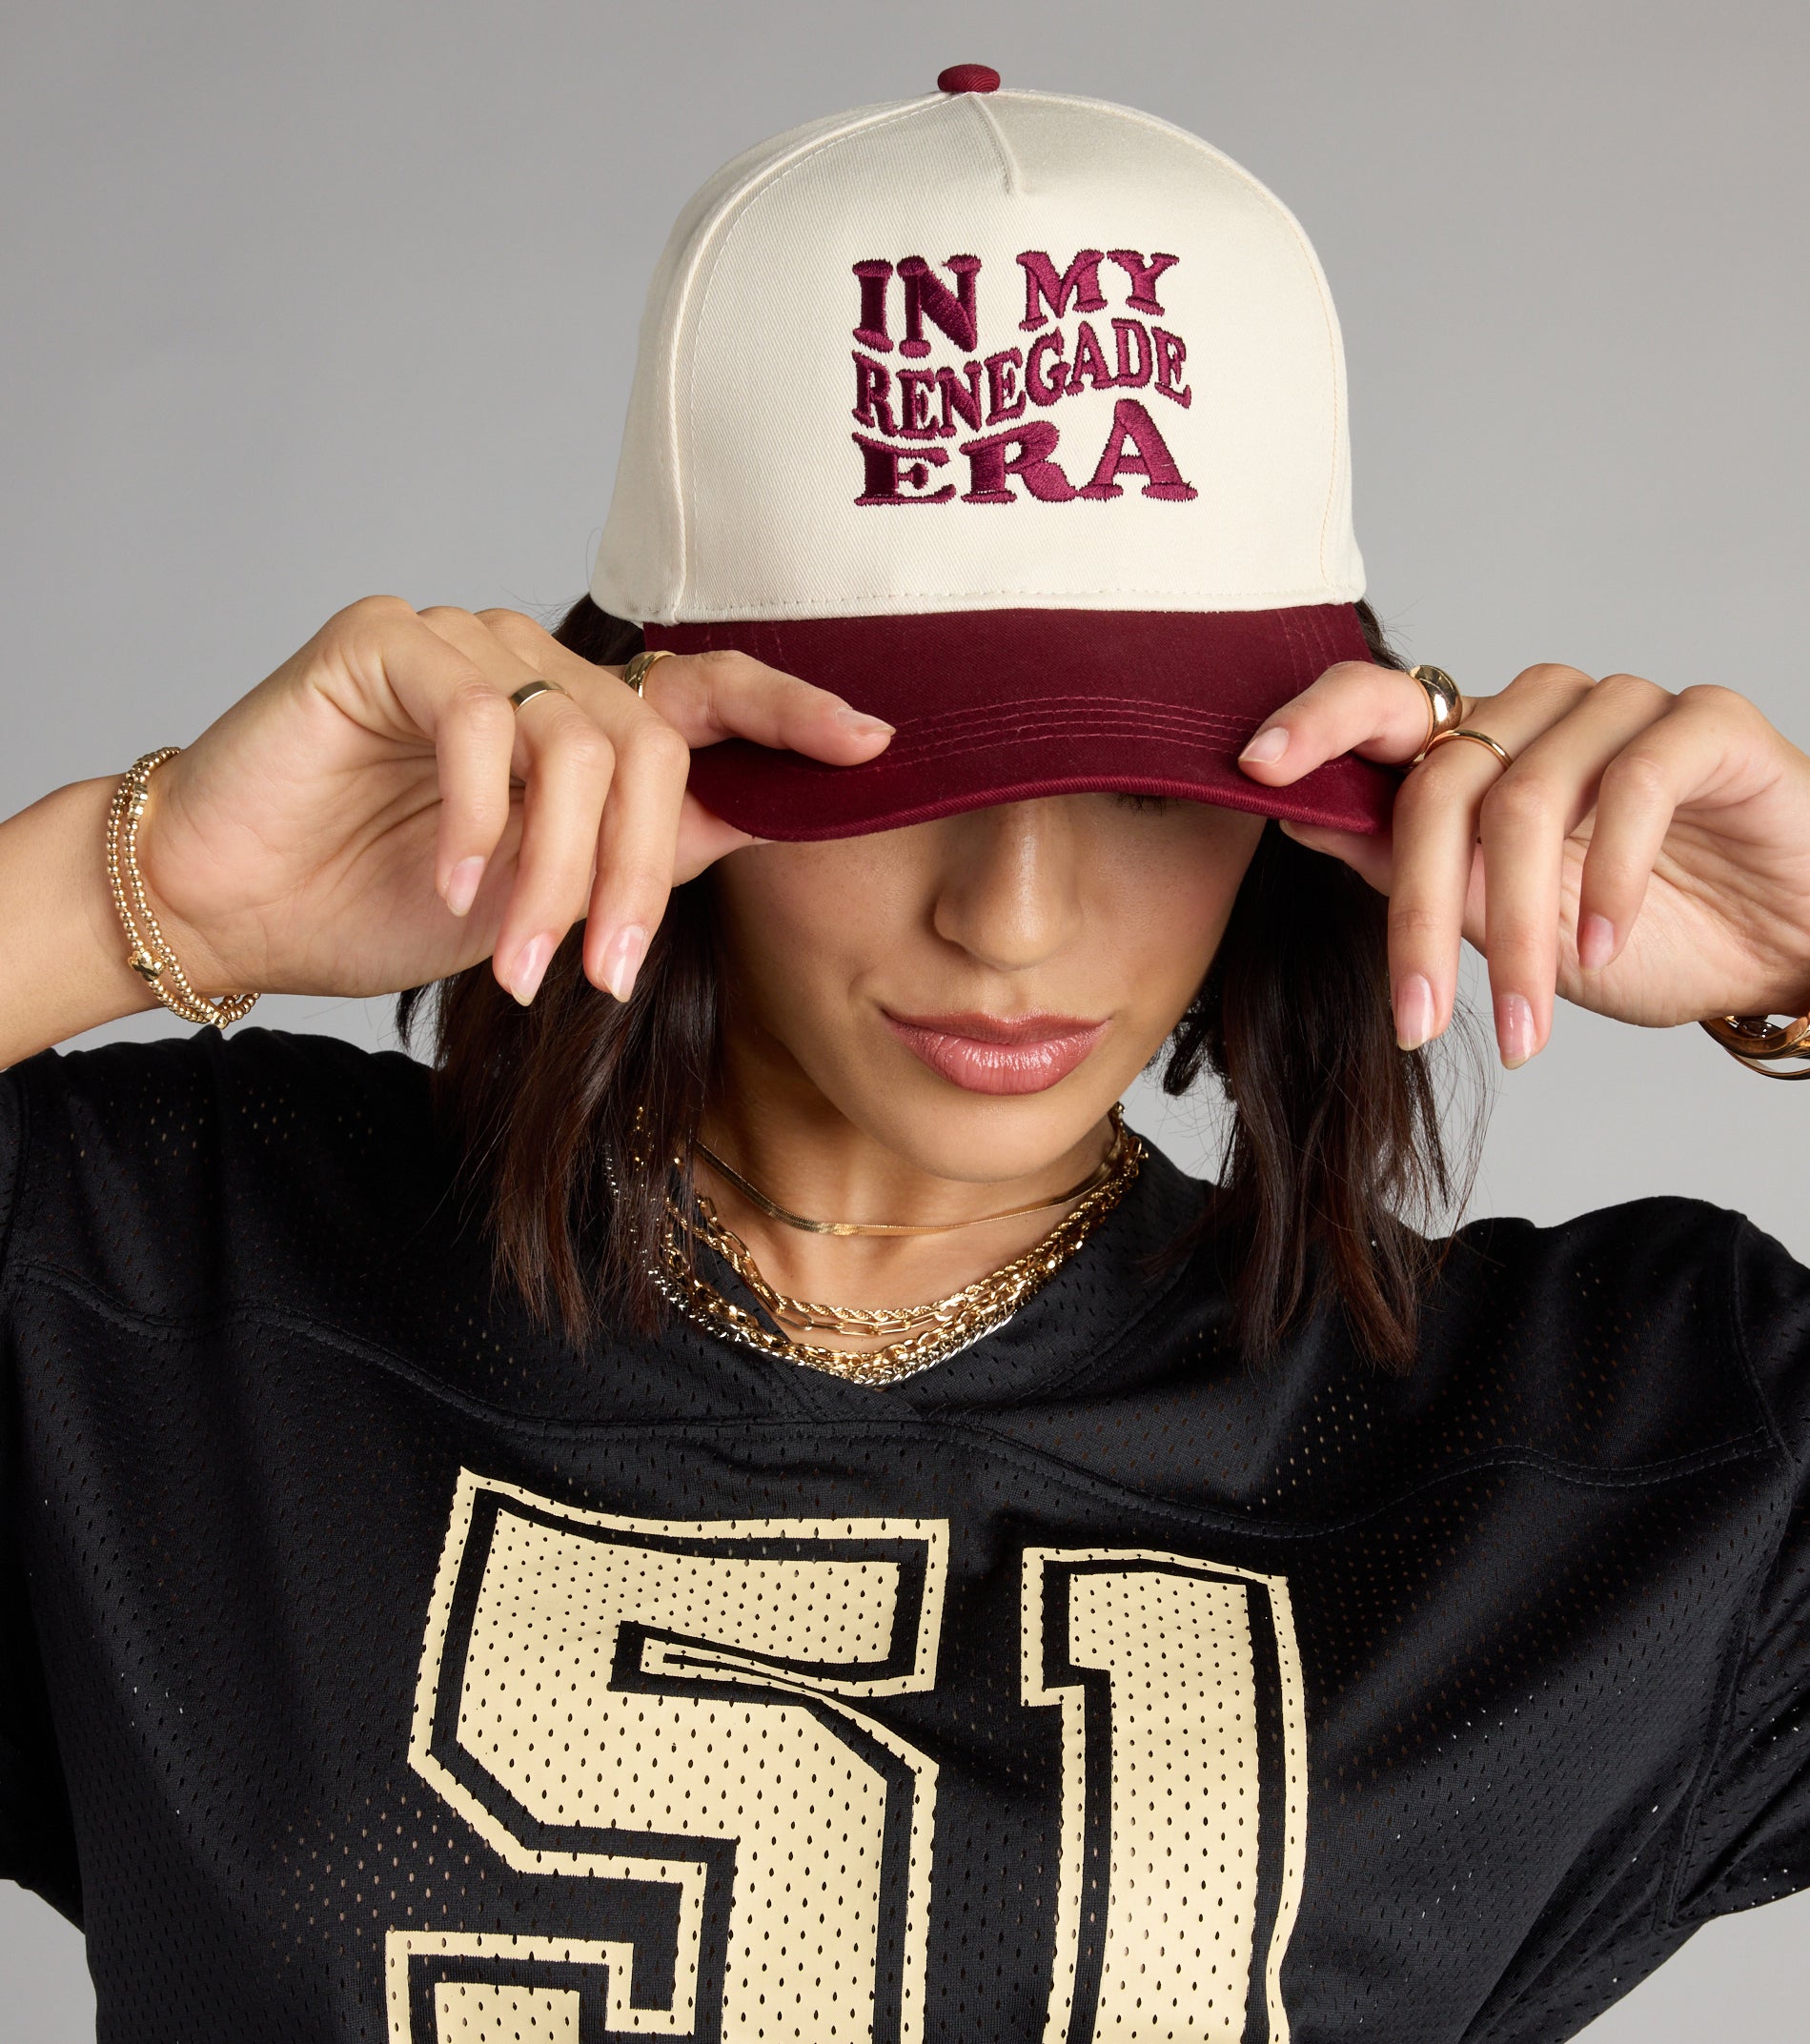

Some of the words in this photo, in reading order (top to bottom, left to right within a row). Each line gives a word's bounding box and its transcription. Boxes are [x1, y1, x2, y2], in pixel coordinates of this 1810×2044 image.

[852, 254, 982, 358] IN
[1016, 249, 1180, 332] MY
[852, 318, 1191, 440] RENEGADE
[852, 399, 1198, 506] ERA
[385, 1467, 1308, 2044] 51
